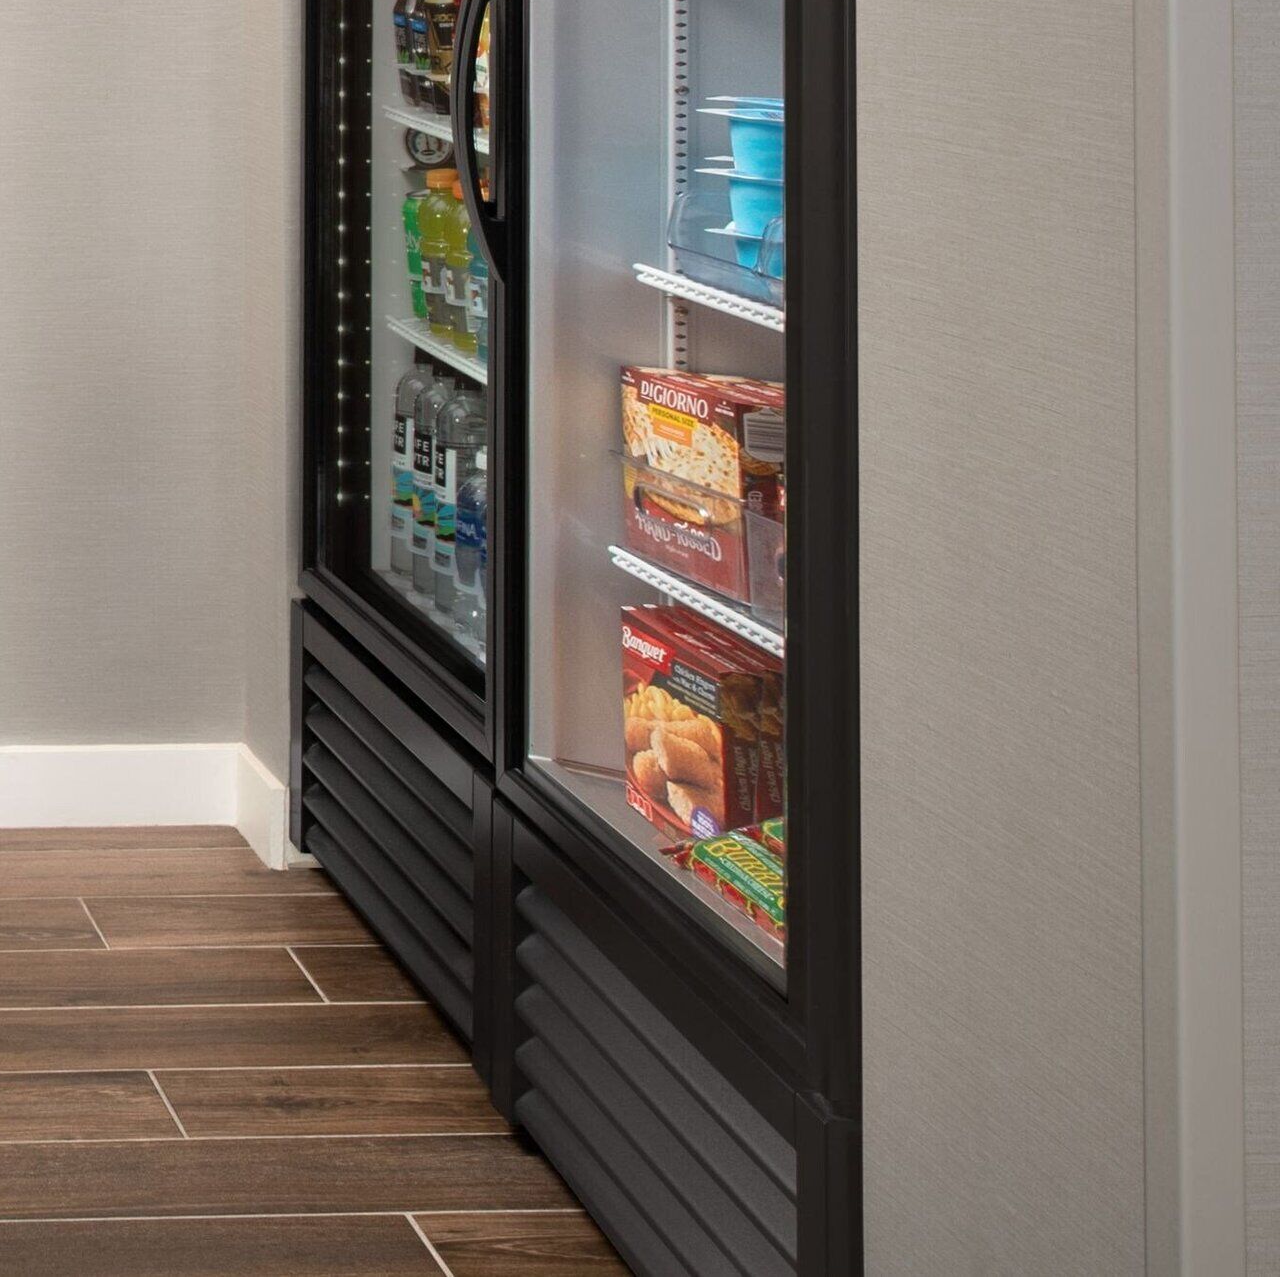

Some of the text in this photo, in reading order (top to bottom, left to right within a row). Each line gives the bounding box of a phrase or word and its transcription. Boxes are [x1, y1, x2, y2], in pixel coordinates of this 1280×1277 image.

[641, 380, 709, 419] DIGIORNO
[622, 625, 668, 665] Banquet
[674, 664, 695, 682] Chicken
